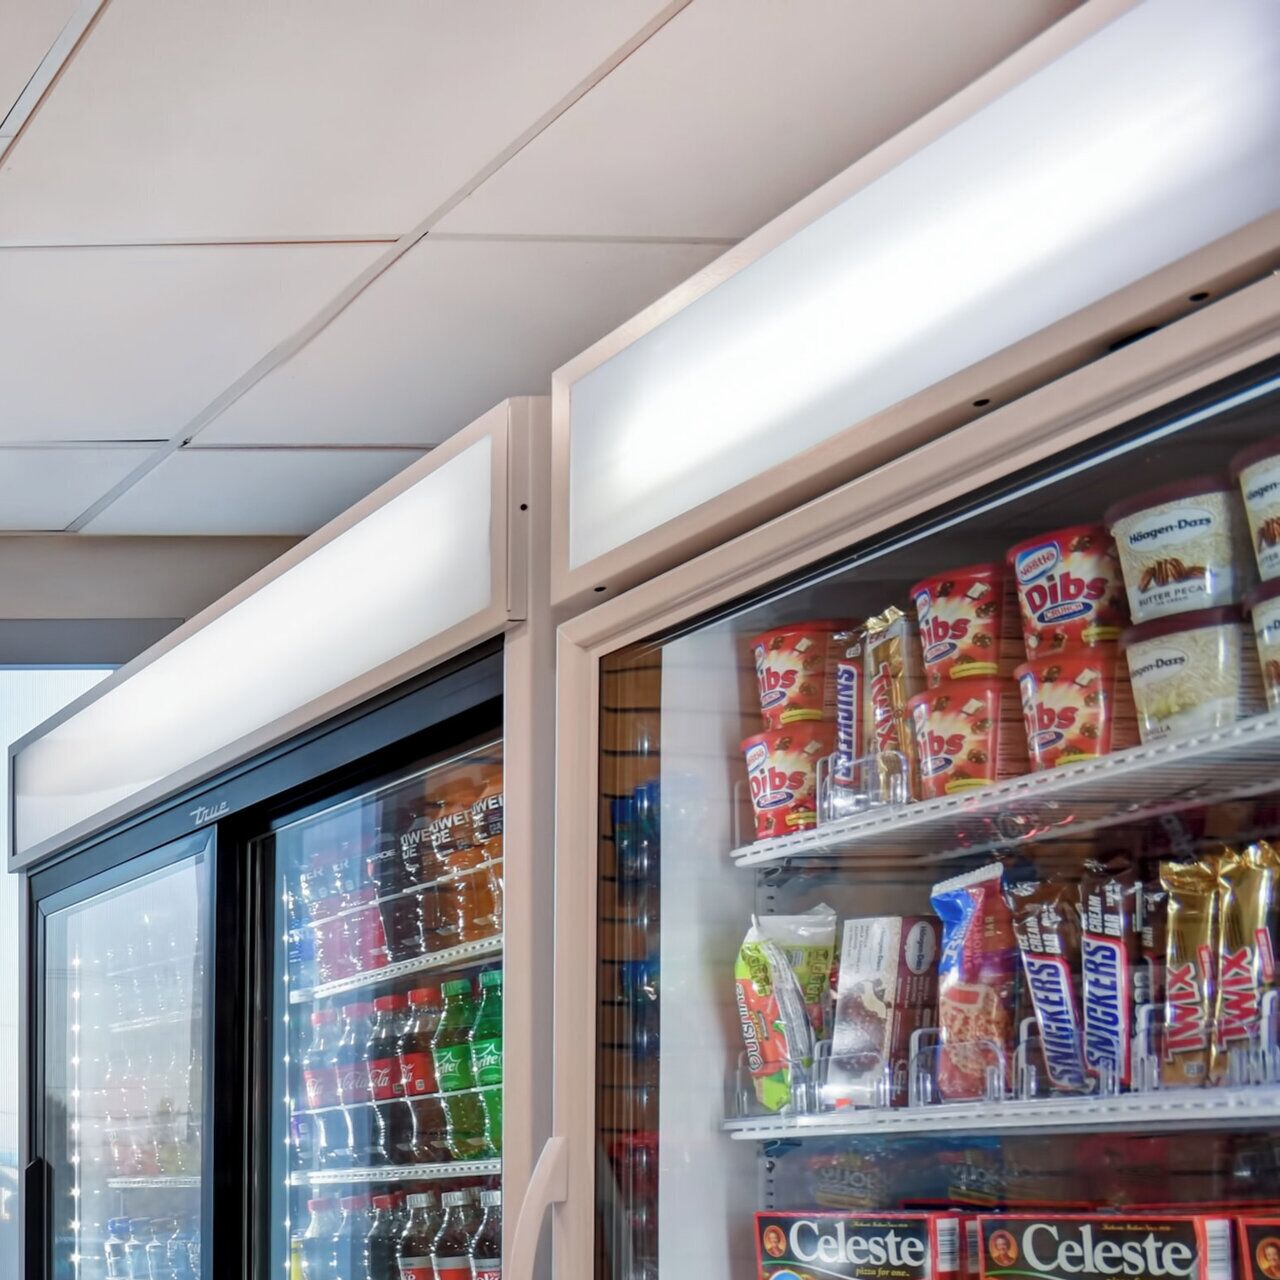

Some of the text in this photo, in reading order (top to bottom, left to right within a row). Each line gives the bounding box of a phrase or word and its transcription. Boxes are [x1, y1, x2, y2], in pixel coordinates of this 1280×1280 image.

[1024, 570, 1108, 615] Dibs
[1173, 583, 1208, 598] PECA
[1043, 602, 1085, 620] CRUNCH
[749, 766, 807, 797] Dibs
[189, 801, 230, 826] true
[1088, 894, 1103, 934] CREAM
[1104, 913, 1121, 937] BAR
[1043, 932, 1062, 955] BAR
[1085, 941, 1118, 1072] SNICKERS
[1163, 962, 1207, 1063] TWIX
[1217, 946, 1260, 1050] TWIX
[1026, 961, 1086, 1087] SNICKERS
[789, 1220, 927, 1267] Celeste
[1022, 1223, 1193, 1277] Celeste
[855, 1267, 876, 1278] pizza
[877, 1268, 890, 1278] for
